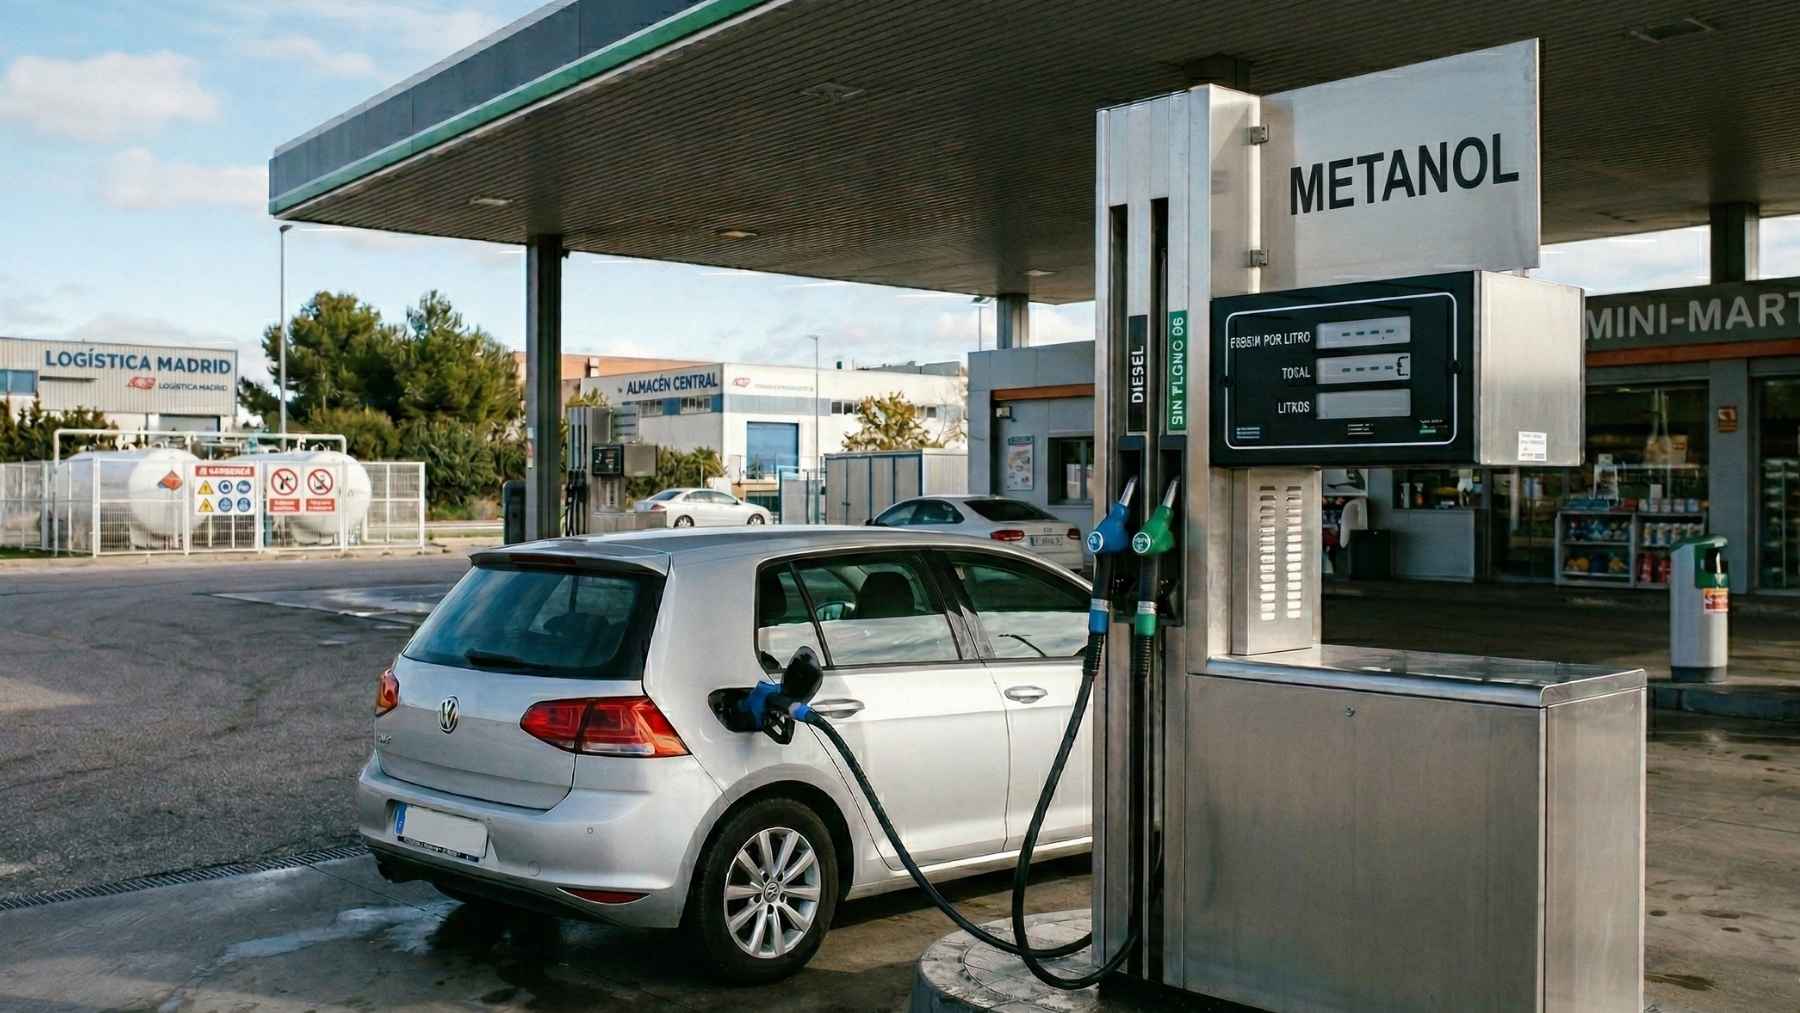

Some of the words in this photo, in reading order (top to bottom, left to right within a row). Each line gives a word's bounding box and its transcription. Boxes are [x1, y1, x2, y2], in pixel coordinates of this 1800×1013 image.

[1290, 132, 1519, 215] METANOL
[1264, 333, 1282, 346] POR
[1284, 331, 1311, 345] LITRO
[45, 348, 151, 371] LOGÍSTICA
[157, 356, 231, 375] MADRID
[1131, 345, 1144, 404] DIESEL
[626, 374, 671, 395] ALMACÉN
[672, 372, 718, 391] CENTRAL
[1171, 400, 1184, 425] SIN
